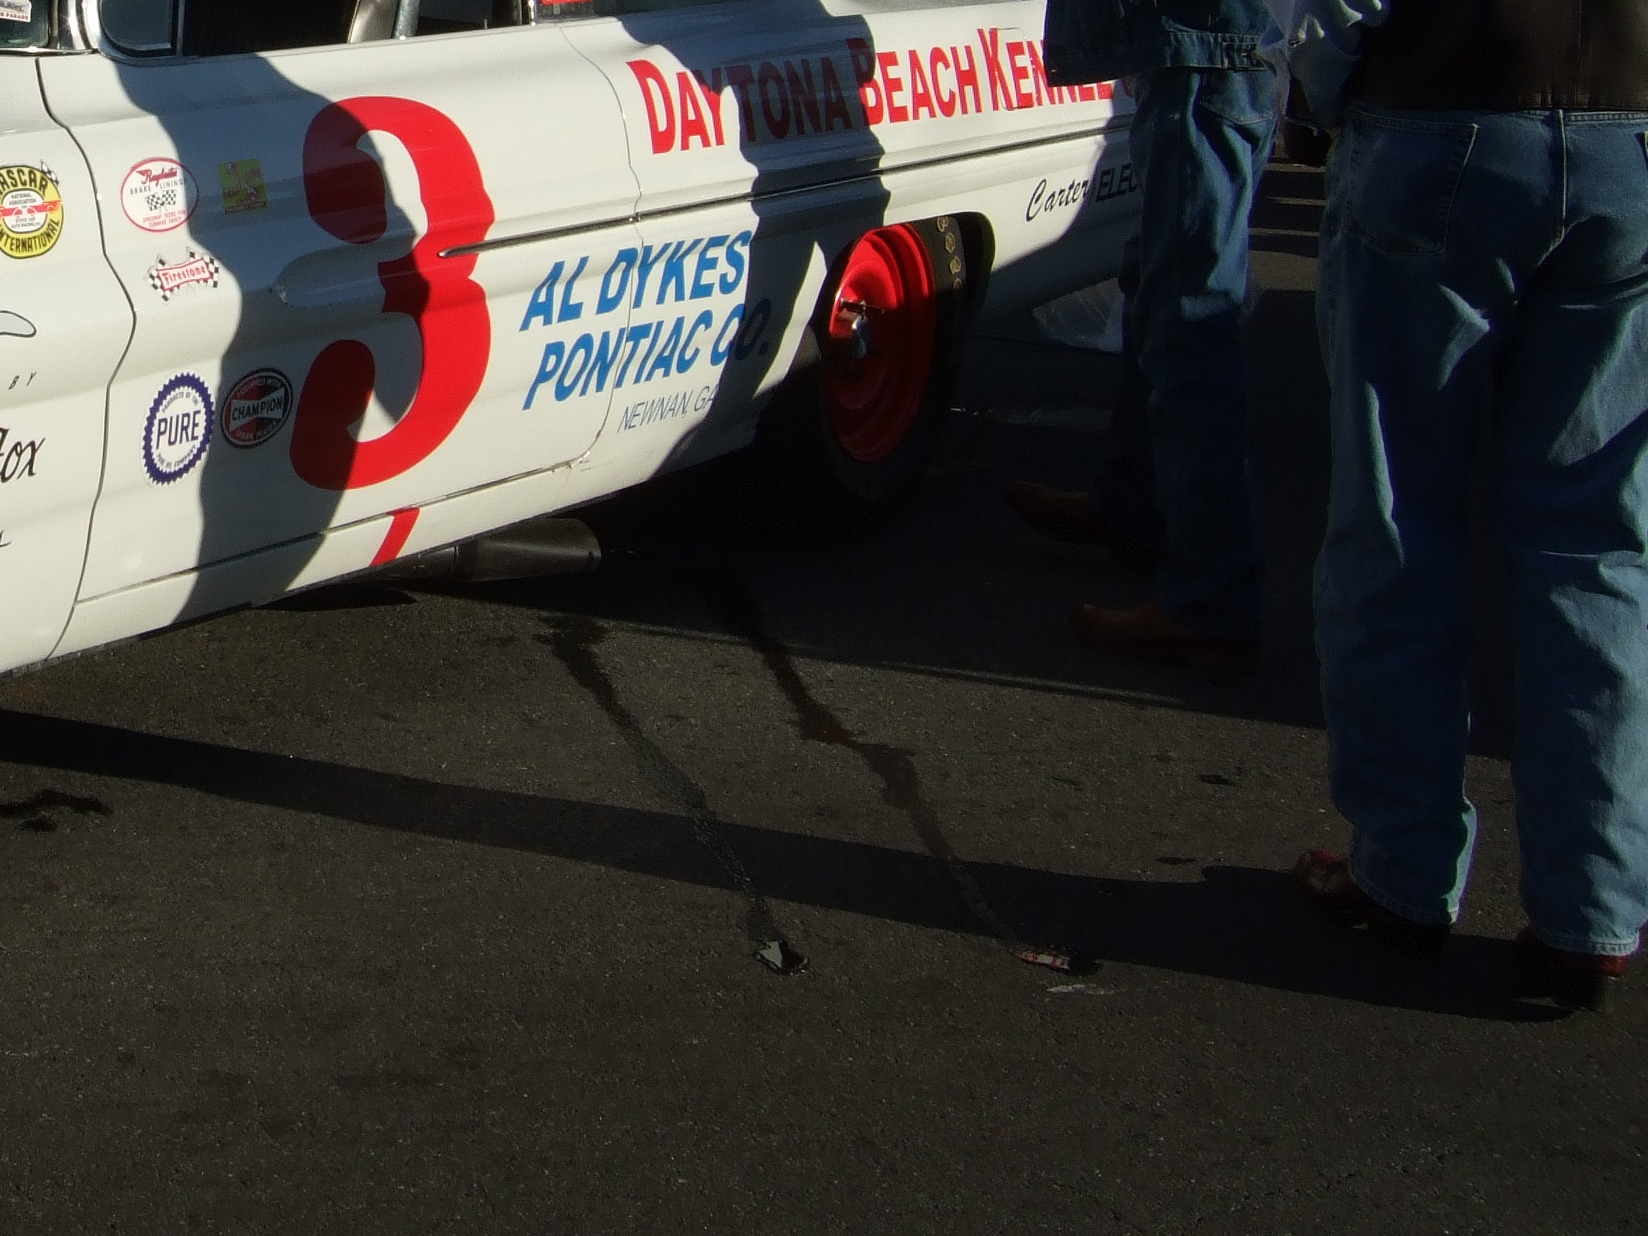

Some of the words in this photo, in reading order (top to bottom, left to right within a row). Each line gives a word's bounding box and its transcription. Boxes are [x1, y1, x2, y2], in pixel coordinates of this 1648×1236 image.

[626, 57, 851, 155] DAYTONA
[846, 36, 982, 127] BEACH
[1025, 178, 1090, 223] Carter
[161, 264, 208, 284] Firestone
[290, 95, 496, 491] 3
[519, 255, 590, 332] AL
[595, 230, 753, 316] DYKES
[522, 309, 713, 412] PONTIAC
[709, 297, 771, 367] CO.
[8, 370, 38, 391] BY
[155, 408, 202, 450] PURE
[232, 397, 284, 421] CHAMPION
